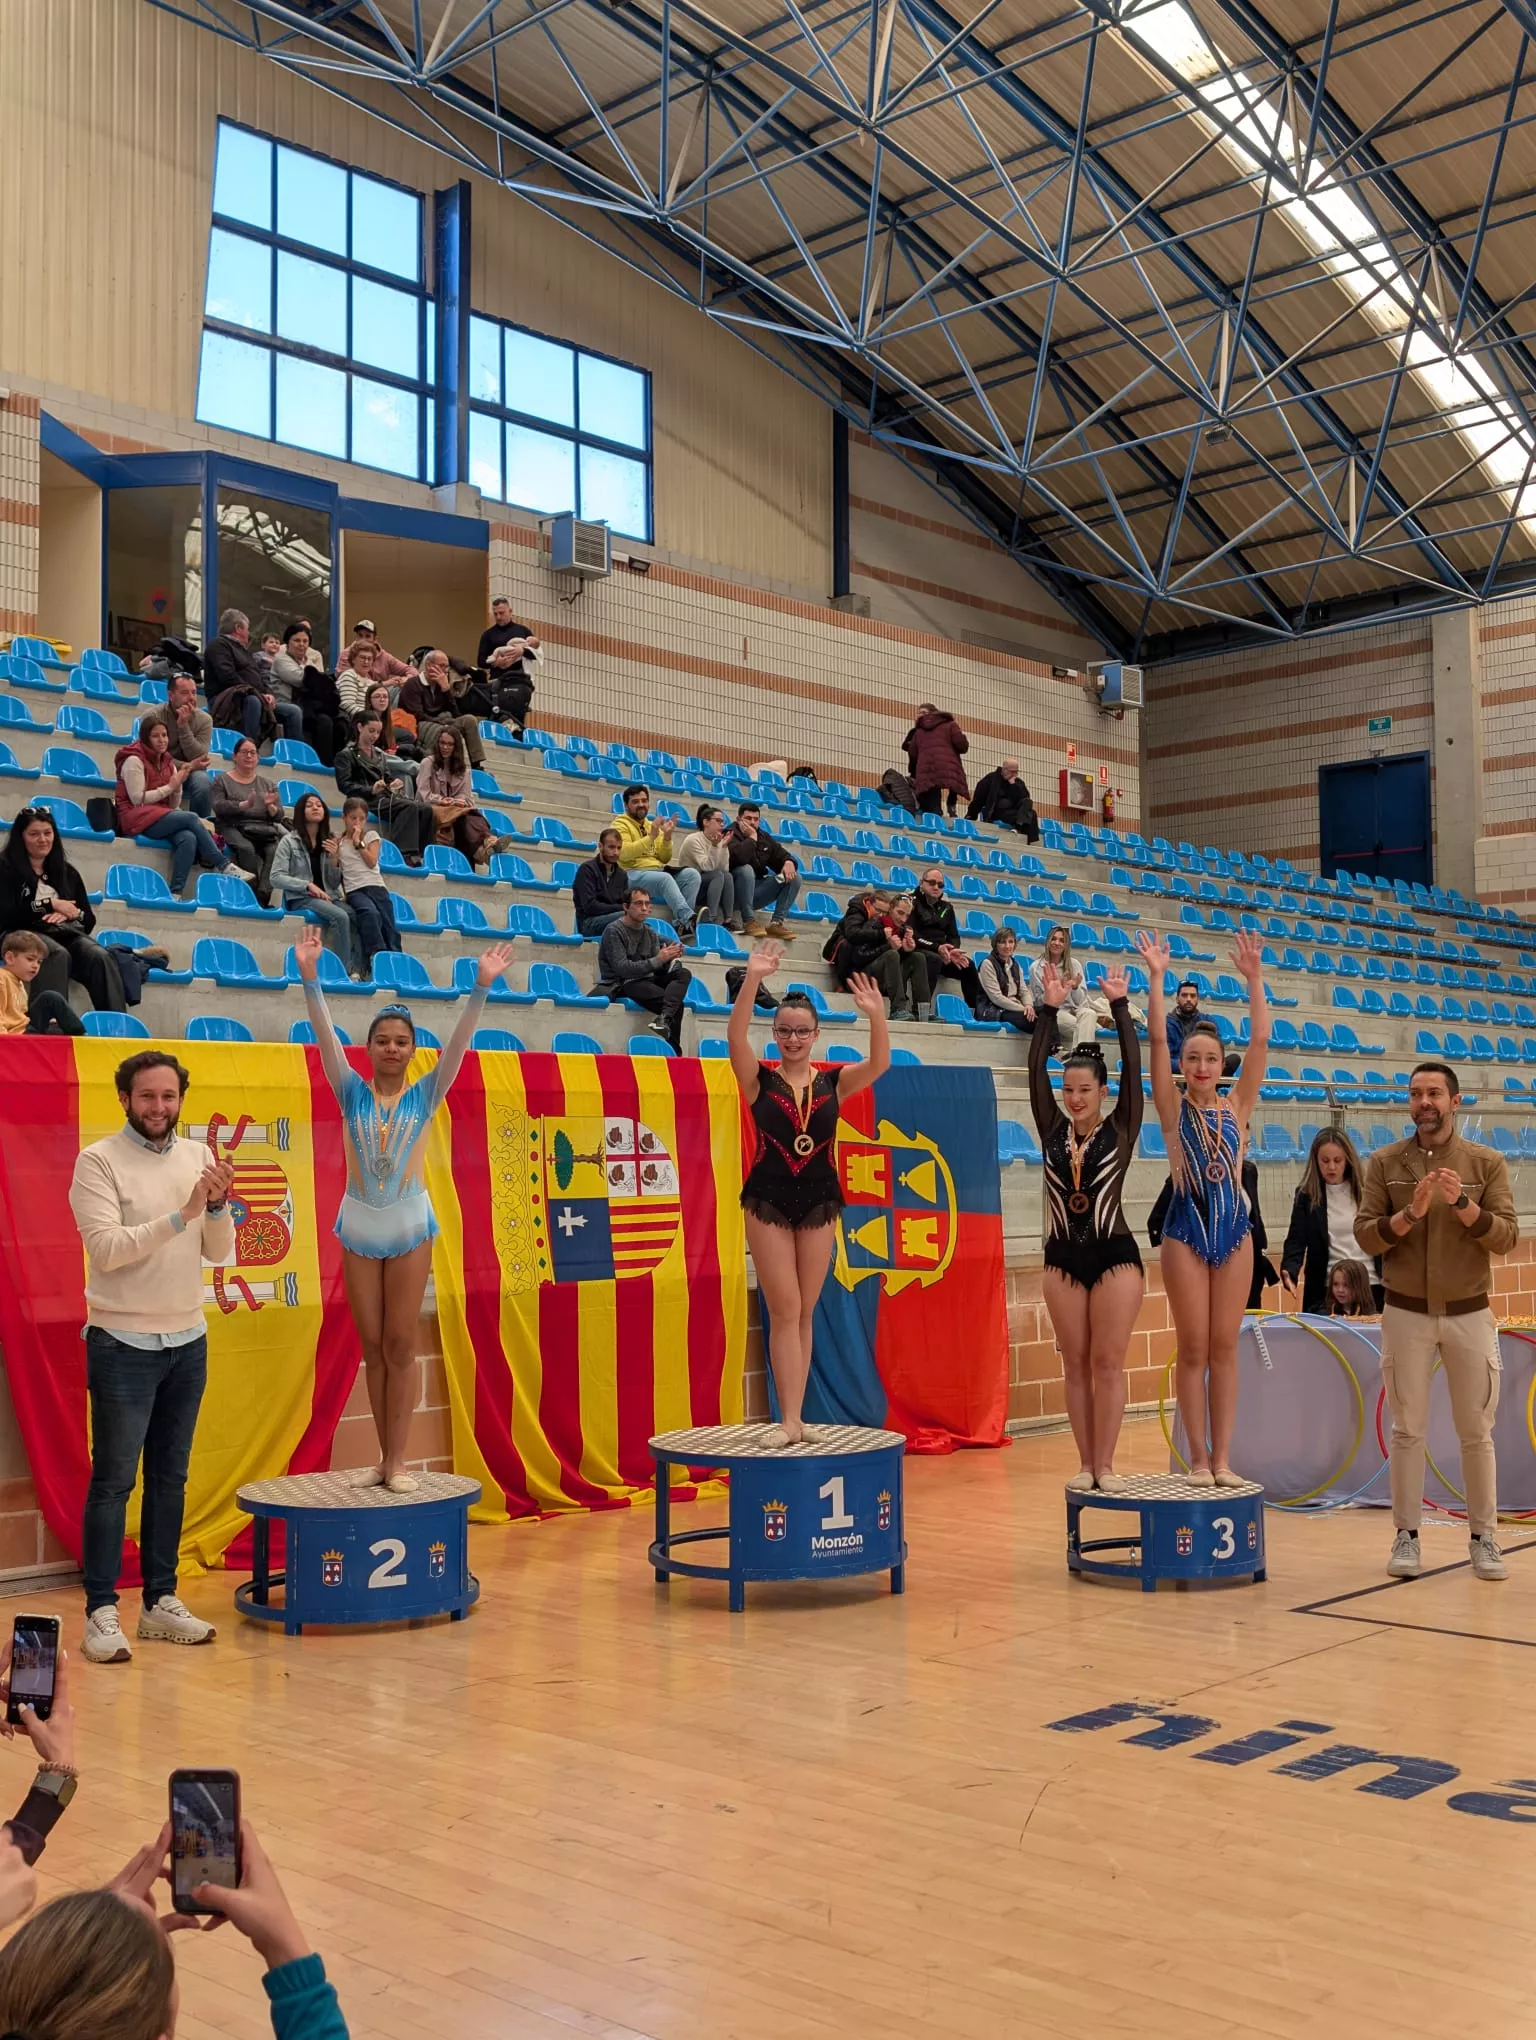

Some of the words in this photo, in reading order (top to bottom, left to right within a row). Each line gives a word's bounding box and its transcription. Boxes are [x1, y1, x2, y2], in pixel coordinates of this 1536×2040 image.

[819, 1476, 854, 1531] 1
[811, 1532, 863, 1550] Monzón
[812, 1546, 864, 1560] Ayuntamiento
[1211, 1517, 1236, 1560] 3
[367, 1538, 408, 1589] 2
